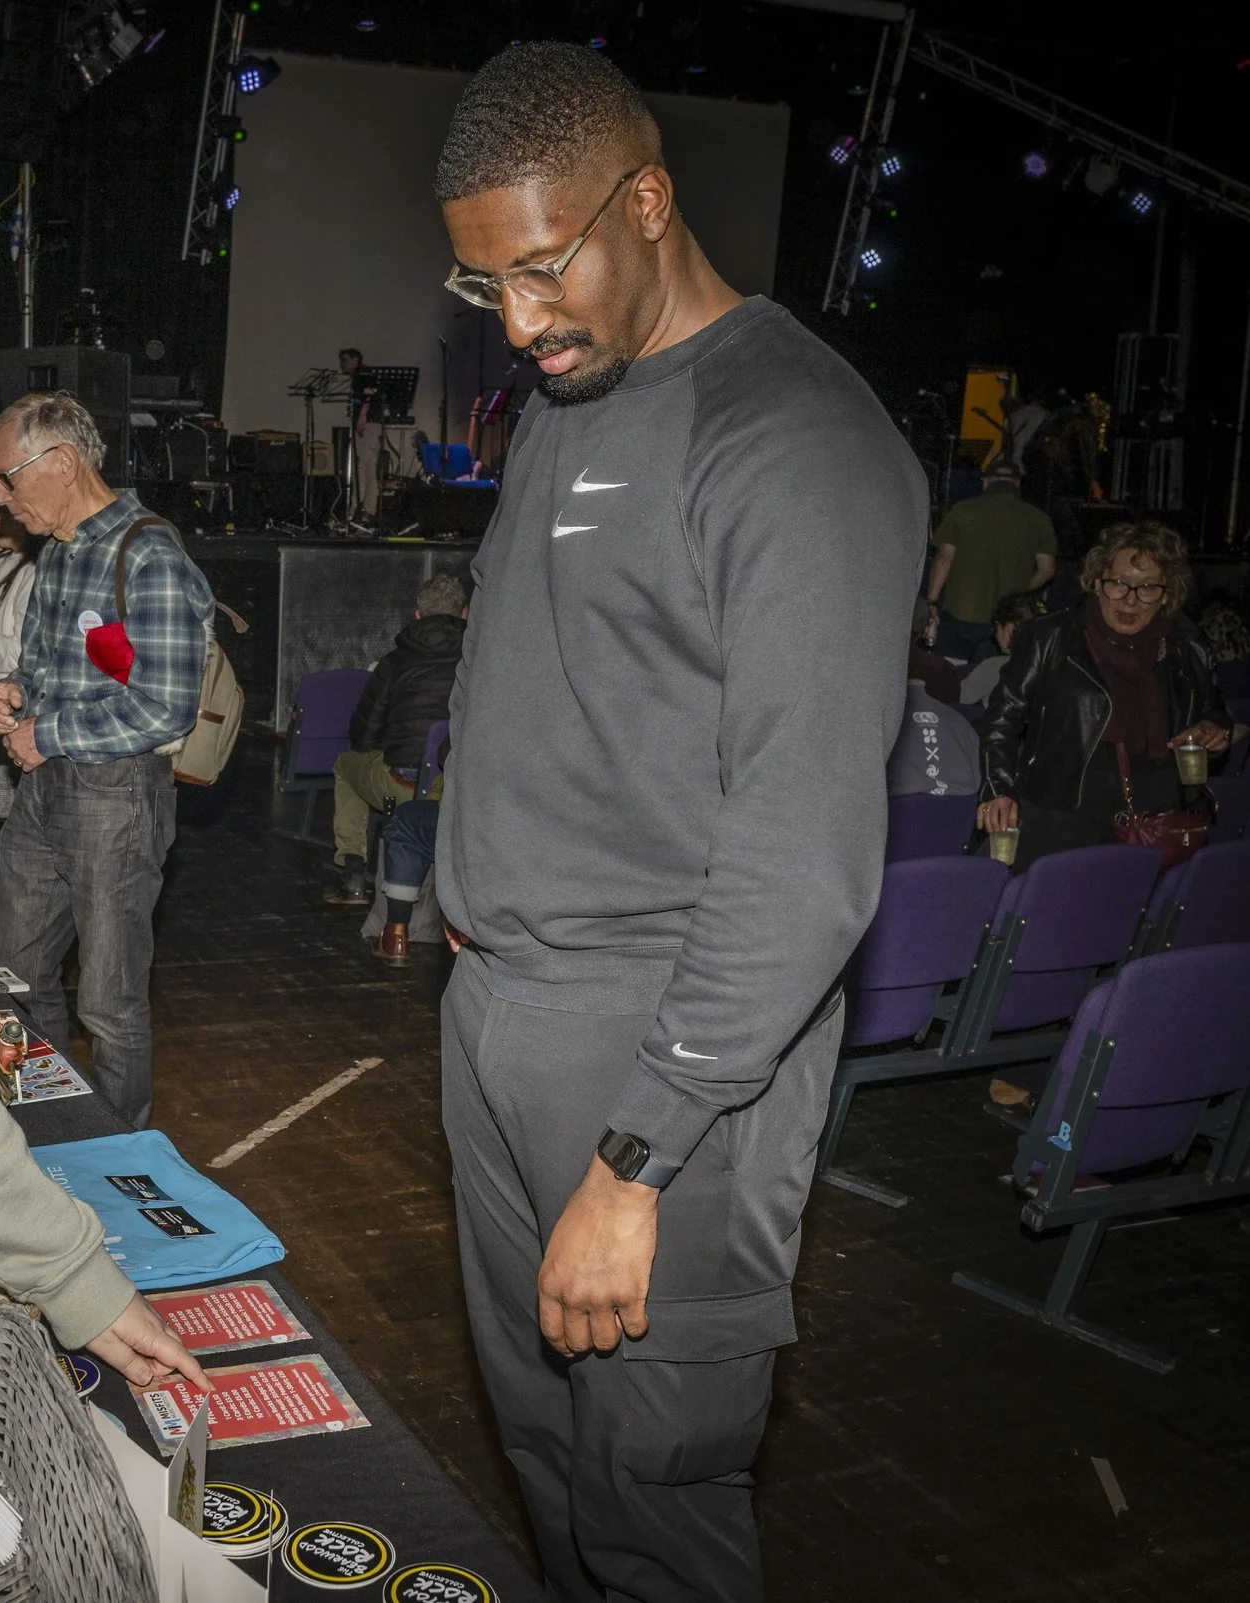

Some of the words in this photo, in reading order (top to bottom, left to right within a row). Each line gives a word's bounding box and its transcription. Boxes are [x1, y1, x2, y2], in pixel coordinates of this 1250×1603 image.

[175, 1383, 193, 1403] Merch
[150, 1393, 170, 1419] MISFITS
[314, 1532, 376, 1564] ROCK
[323, 1528, 365, 1548] COLLECTIVE
[299, 1541, 368, 1575] BEARWOOD
[337, 1566, 353, 1577] THE
[419, 1570, 465, 1590] COLLECTIVE
[413, 1577, 478, 1603] ROCK
